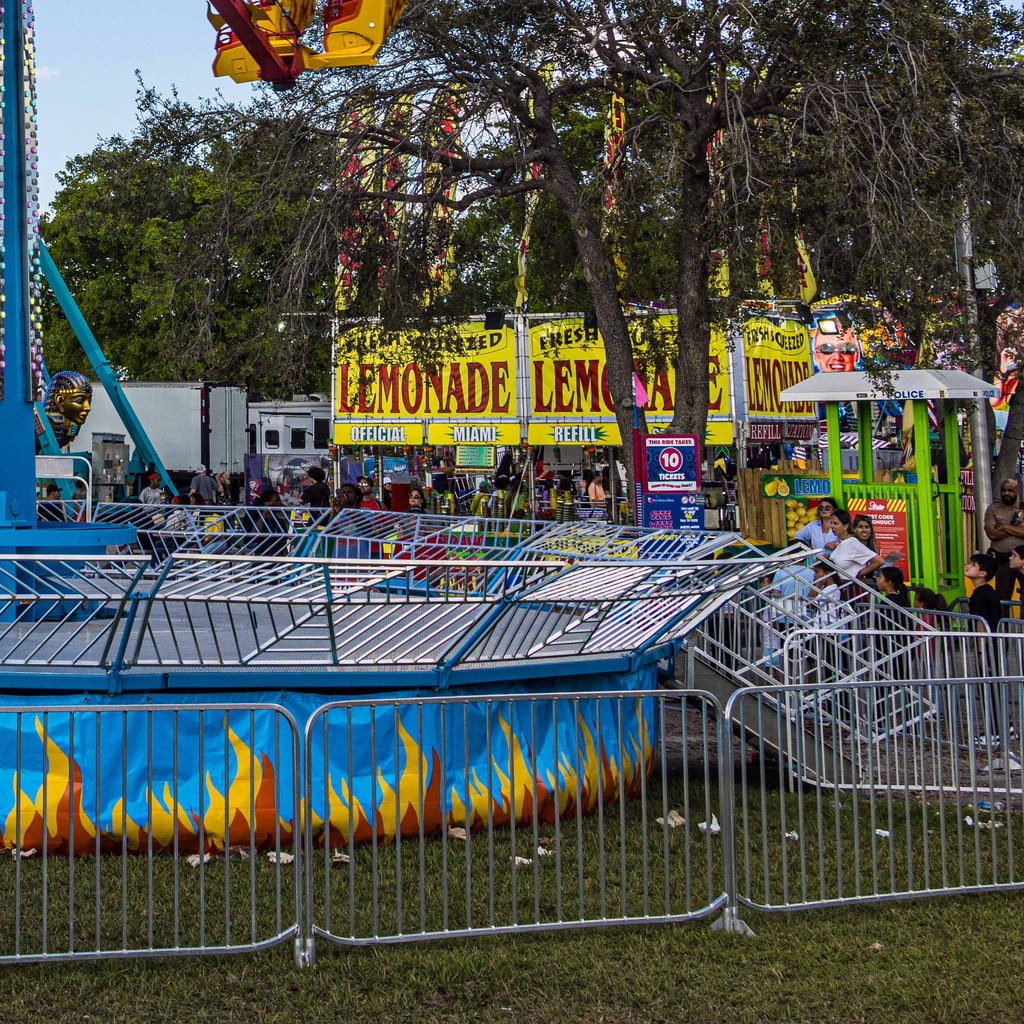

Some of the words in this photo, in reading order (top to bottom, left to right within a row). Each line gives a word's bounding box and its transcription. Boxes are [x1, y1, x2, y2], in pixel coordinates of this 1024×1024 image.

[540, 327, 599, 350] FRESH
[747, 326, 769, 346] FRESH
[771, 330, 804, 351] SQUEEZED
[339, 361, 511, 414] LEMONADE
[887, 390, 924, 398] POLICE
[983, 390, 995, 398] POLICE
[351, 426, 407, 442] OFFICIAL
[453, 426, 497, 442] MIAMI
[554, 426, 599, 442] REFILL
[751, 423, 782, 440] REFILL
[662, 453, 679, 468] 10
